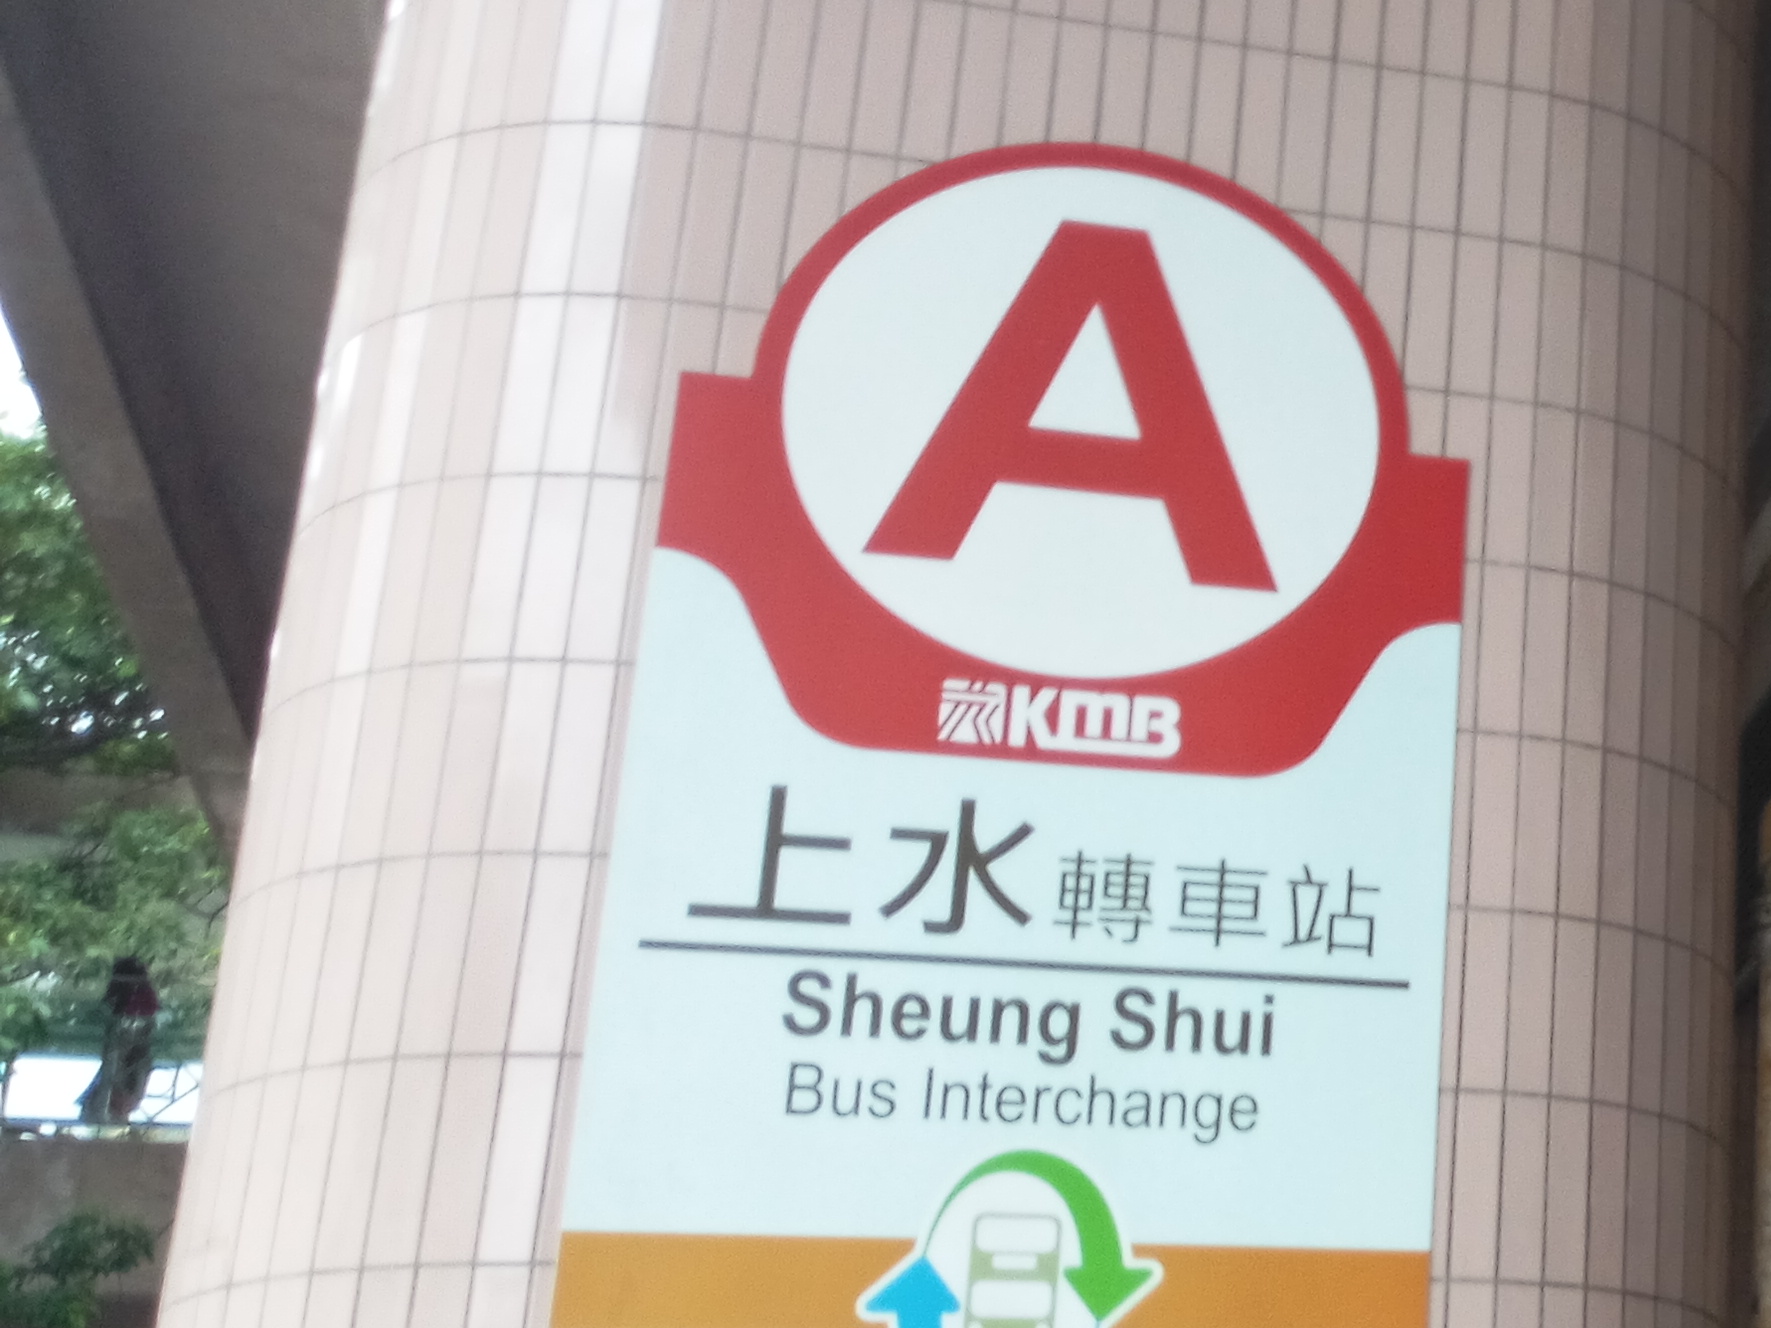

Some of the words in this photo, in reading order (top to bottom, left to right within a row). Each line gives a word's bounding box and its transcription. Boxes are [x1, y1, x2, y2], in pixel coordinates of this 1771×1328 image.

[860, 219, 1278, 593] A
[1008, 684, 1181, 759] KMB
[782, 969, 1081, 1064] Sheung
[1108, 987, 1276, 1057] Shui
[784, 1062, 896, 1120] Bus
[922, 1067, 1260, 1144] Interchange
